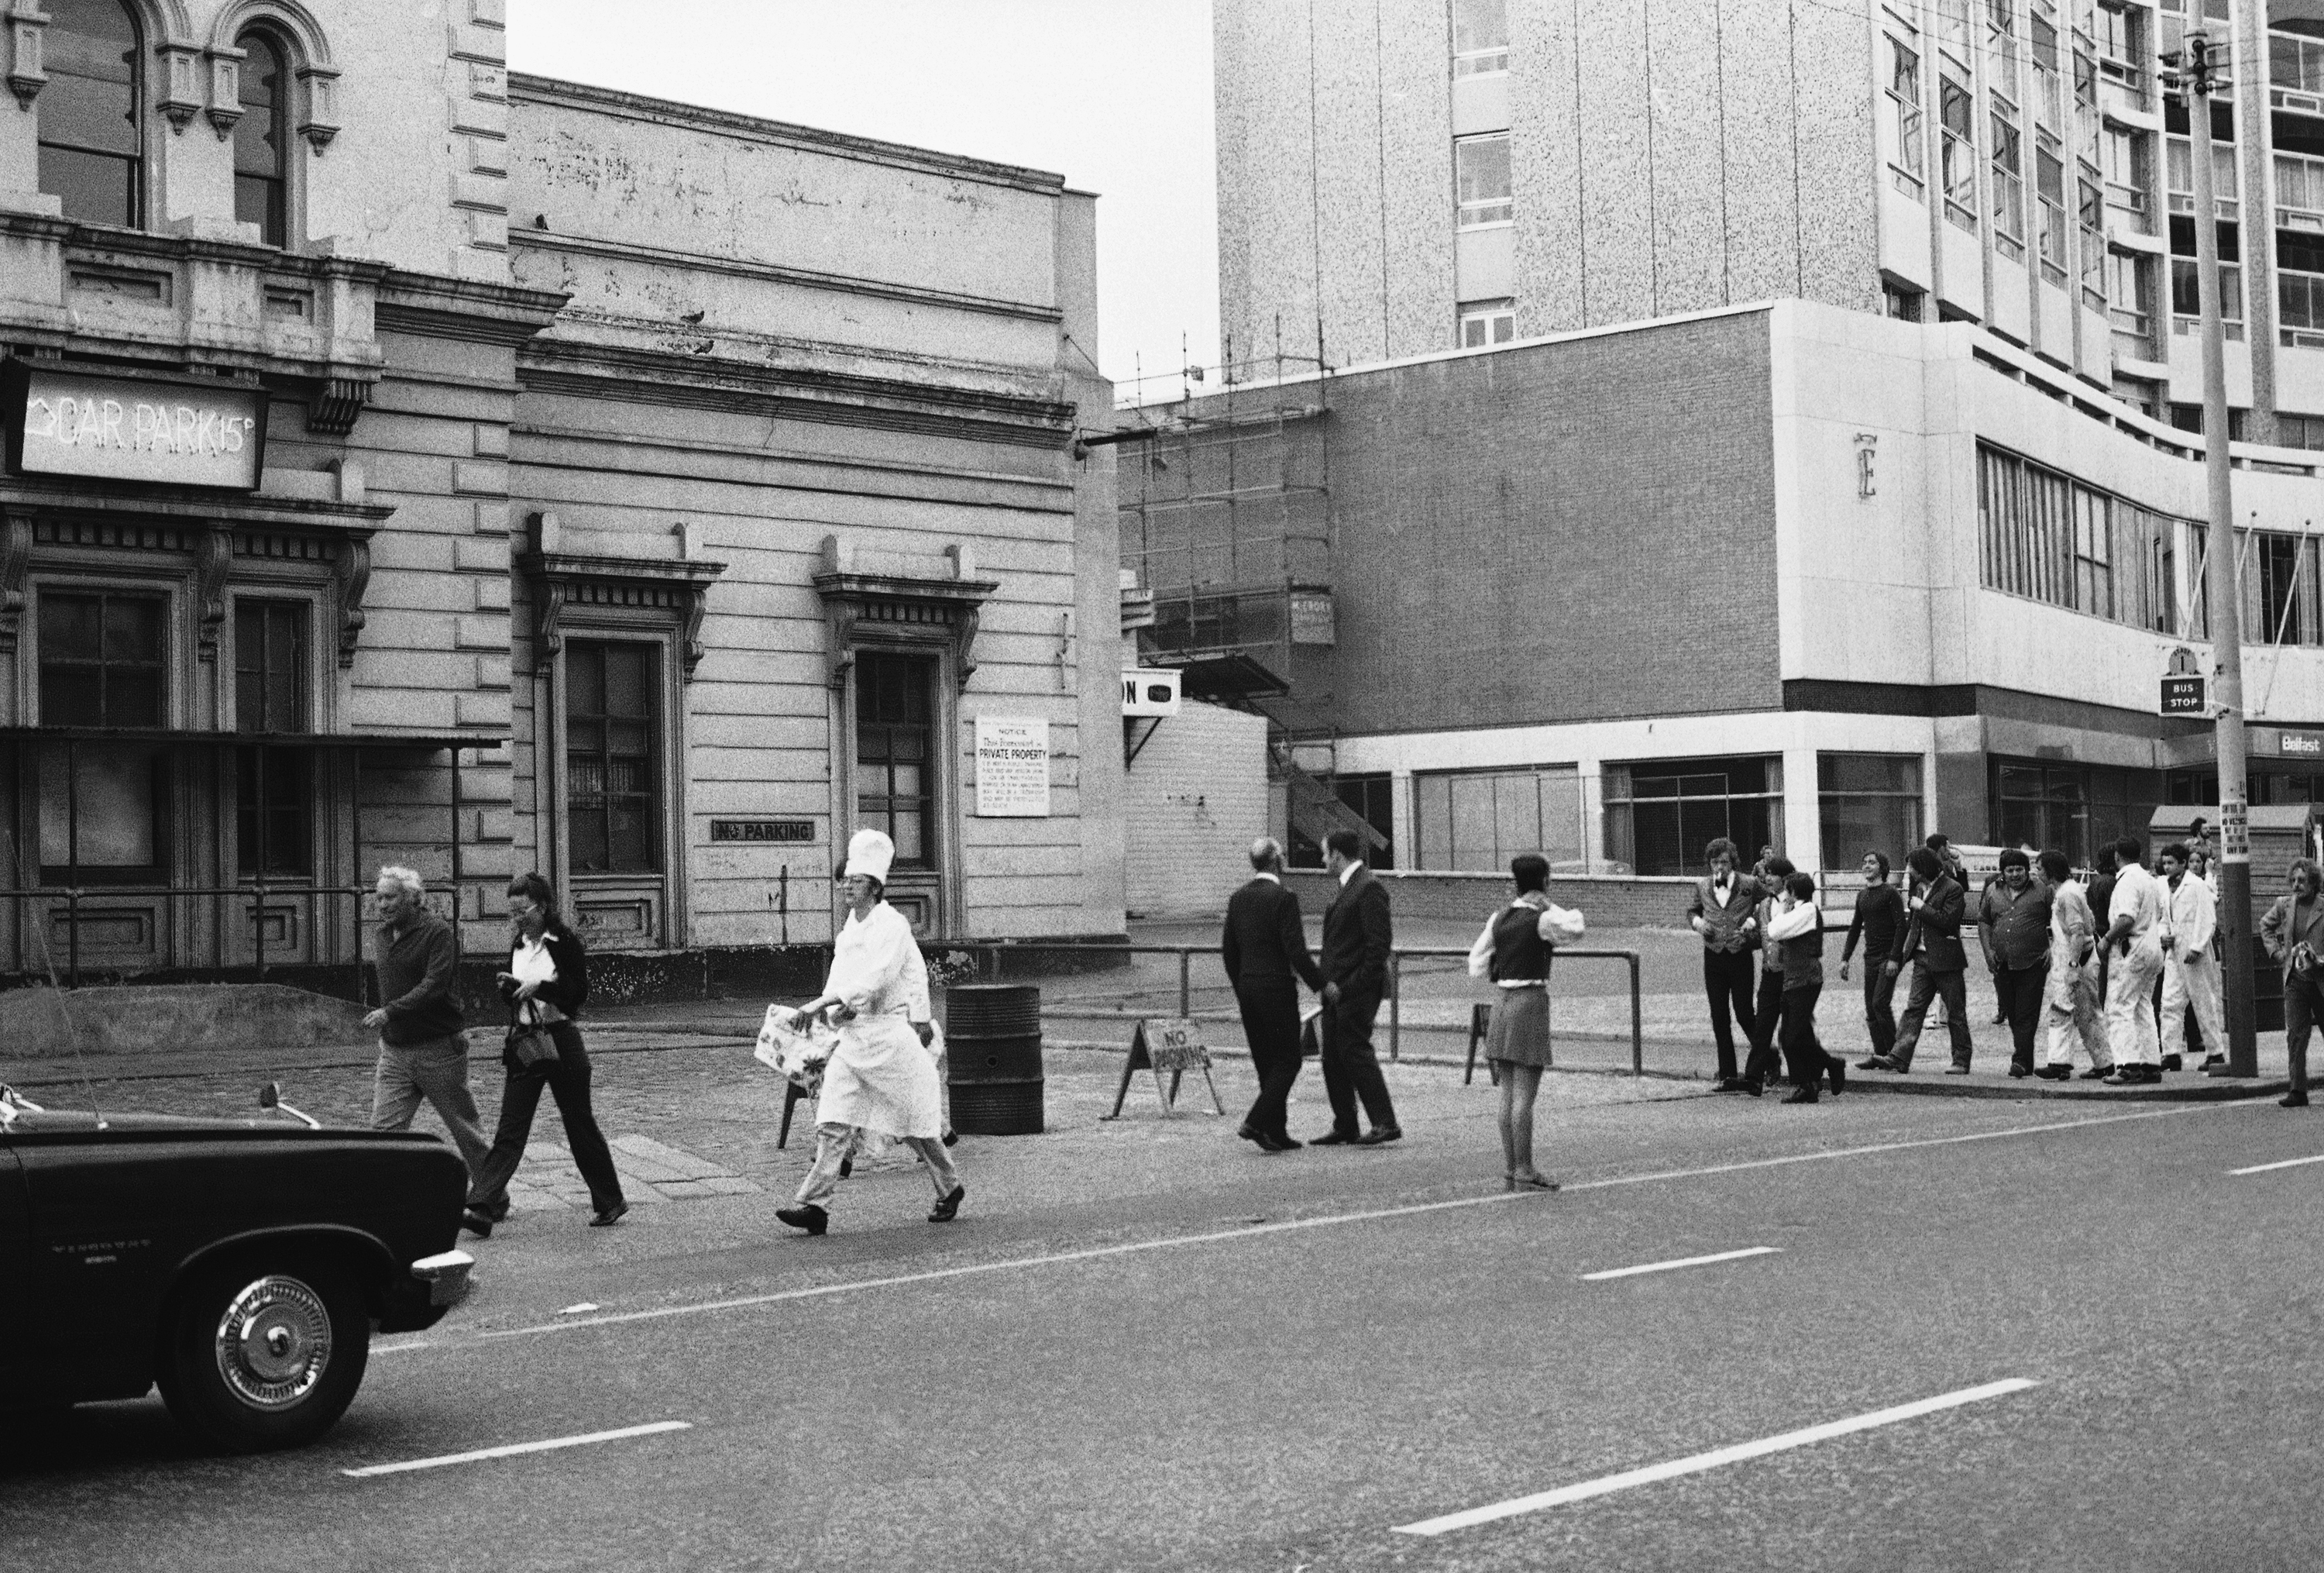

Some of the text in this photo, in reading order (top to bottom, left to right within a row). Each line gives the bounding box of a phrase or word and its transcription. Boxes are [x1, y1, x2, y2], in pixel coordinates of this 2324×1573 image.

[59, 398, 123, 448] CAR
[137, 403, 218, 457] PARK
[2174, 684, 2194, 694] BUS
[2171, 698, 2198, 707] STOP
[2282, 735, 2321, 752] Belfast
[979, 749, 1047, 760] PRIVATE PROPERTY
[718, 824, 809, 840] NO PARKING
[1164, 1030, 1187, 1046] NO
